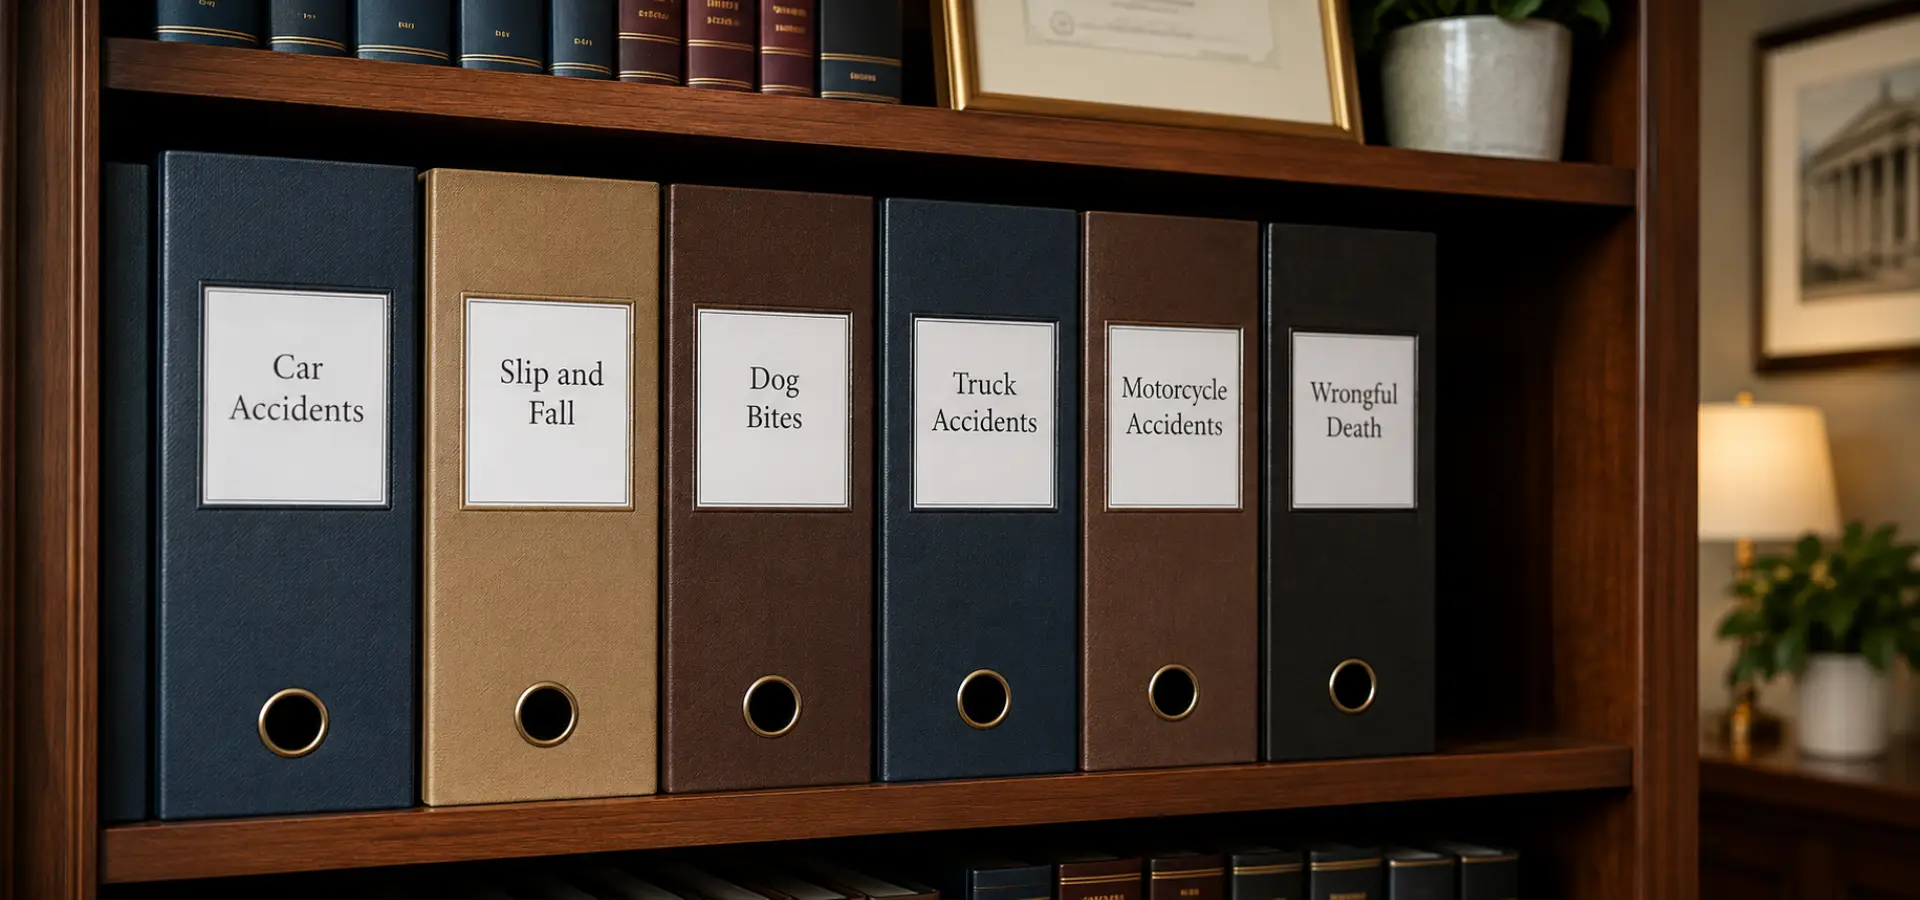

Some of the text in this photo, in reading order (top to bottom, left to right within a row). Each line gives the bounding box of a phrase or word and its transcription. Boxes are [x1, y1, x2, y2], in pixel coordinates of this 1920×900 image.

[273, 353, 324, 380] Car
[500, 357, 605, 393] Slip and
[749, 366, 800, 399] Dog
[952, 371, 1017, 396] Truck
[1121, 376, 1228, 407] Motorcycle
[229, 394, 364, 423] Accidents
[1309, 381, 1398, 412] Wrongful
[528, 399, 575, 426] Fall
[746, 404, 803, 430] Bites
[931, 407, 1038, 433] Accidents
[1125, 412, 1223, 436] Accidents
[1326, 415, 1382, 439] Death
